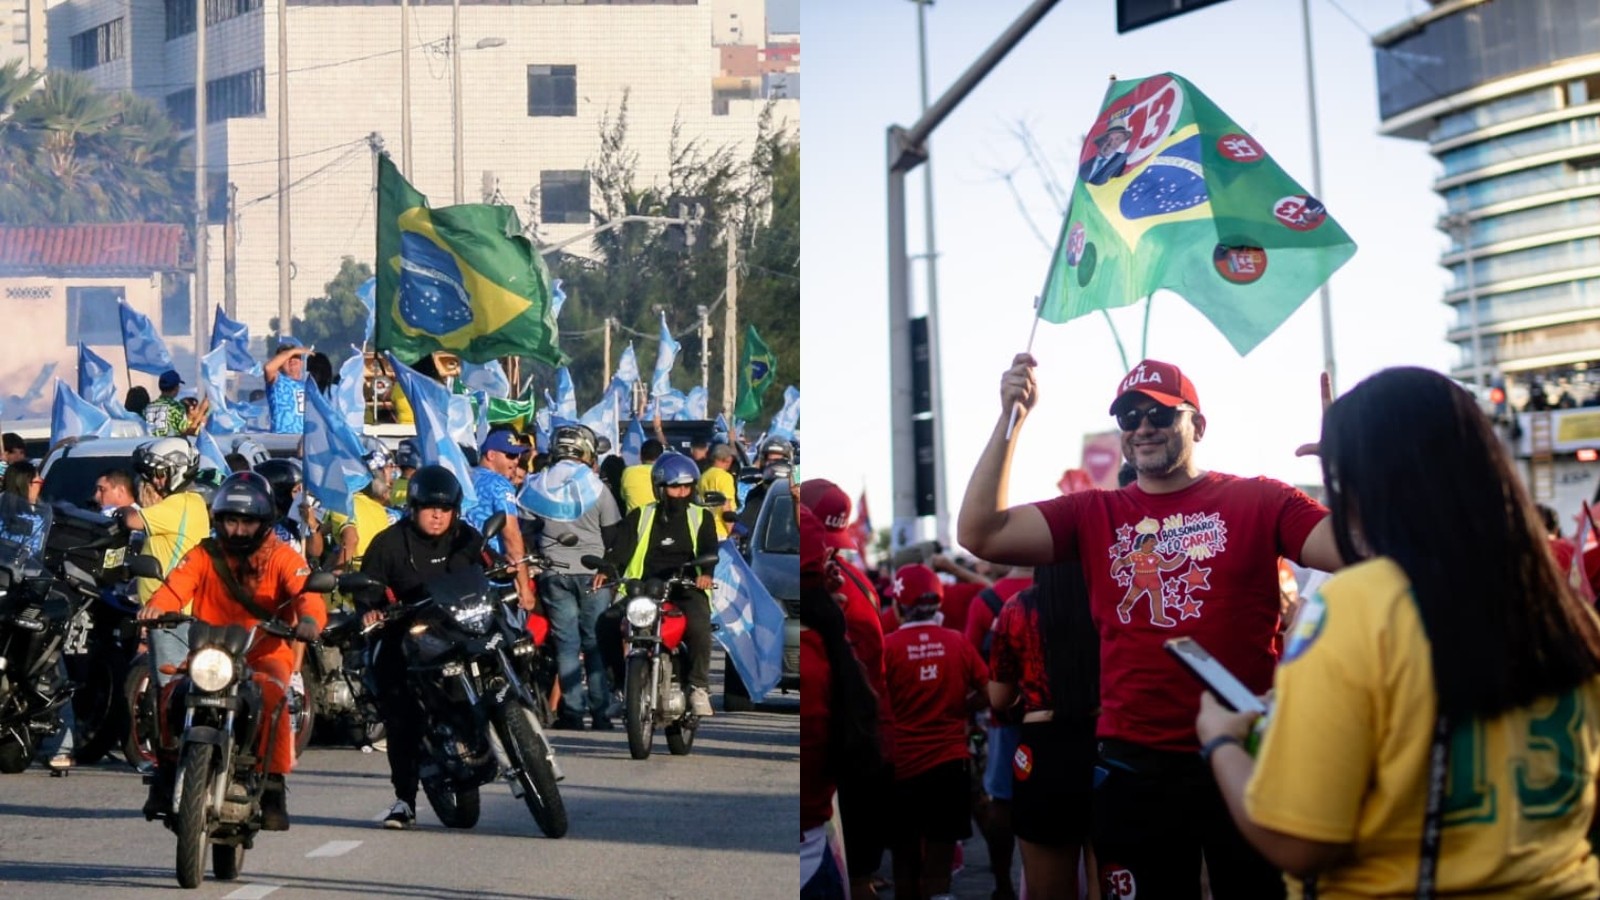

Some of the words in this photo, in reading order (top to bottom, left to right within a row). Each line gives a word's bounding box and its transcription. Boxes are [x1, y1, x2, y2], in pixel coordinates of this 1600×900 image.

[1124, 86, 1176, 153] 13
[1122, 371, 1163, 391] LULA
[1162, 520, 1215, 542] BOLSONARO
